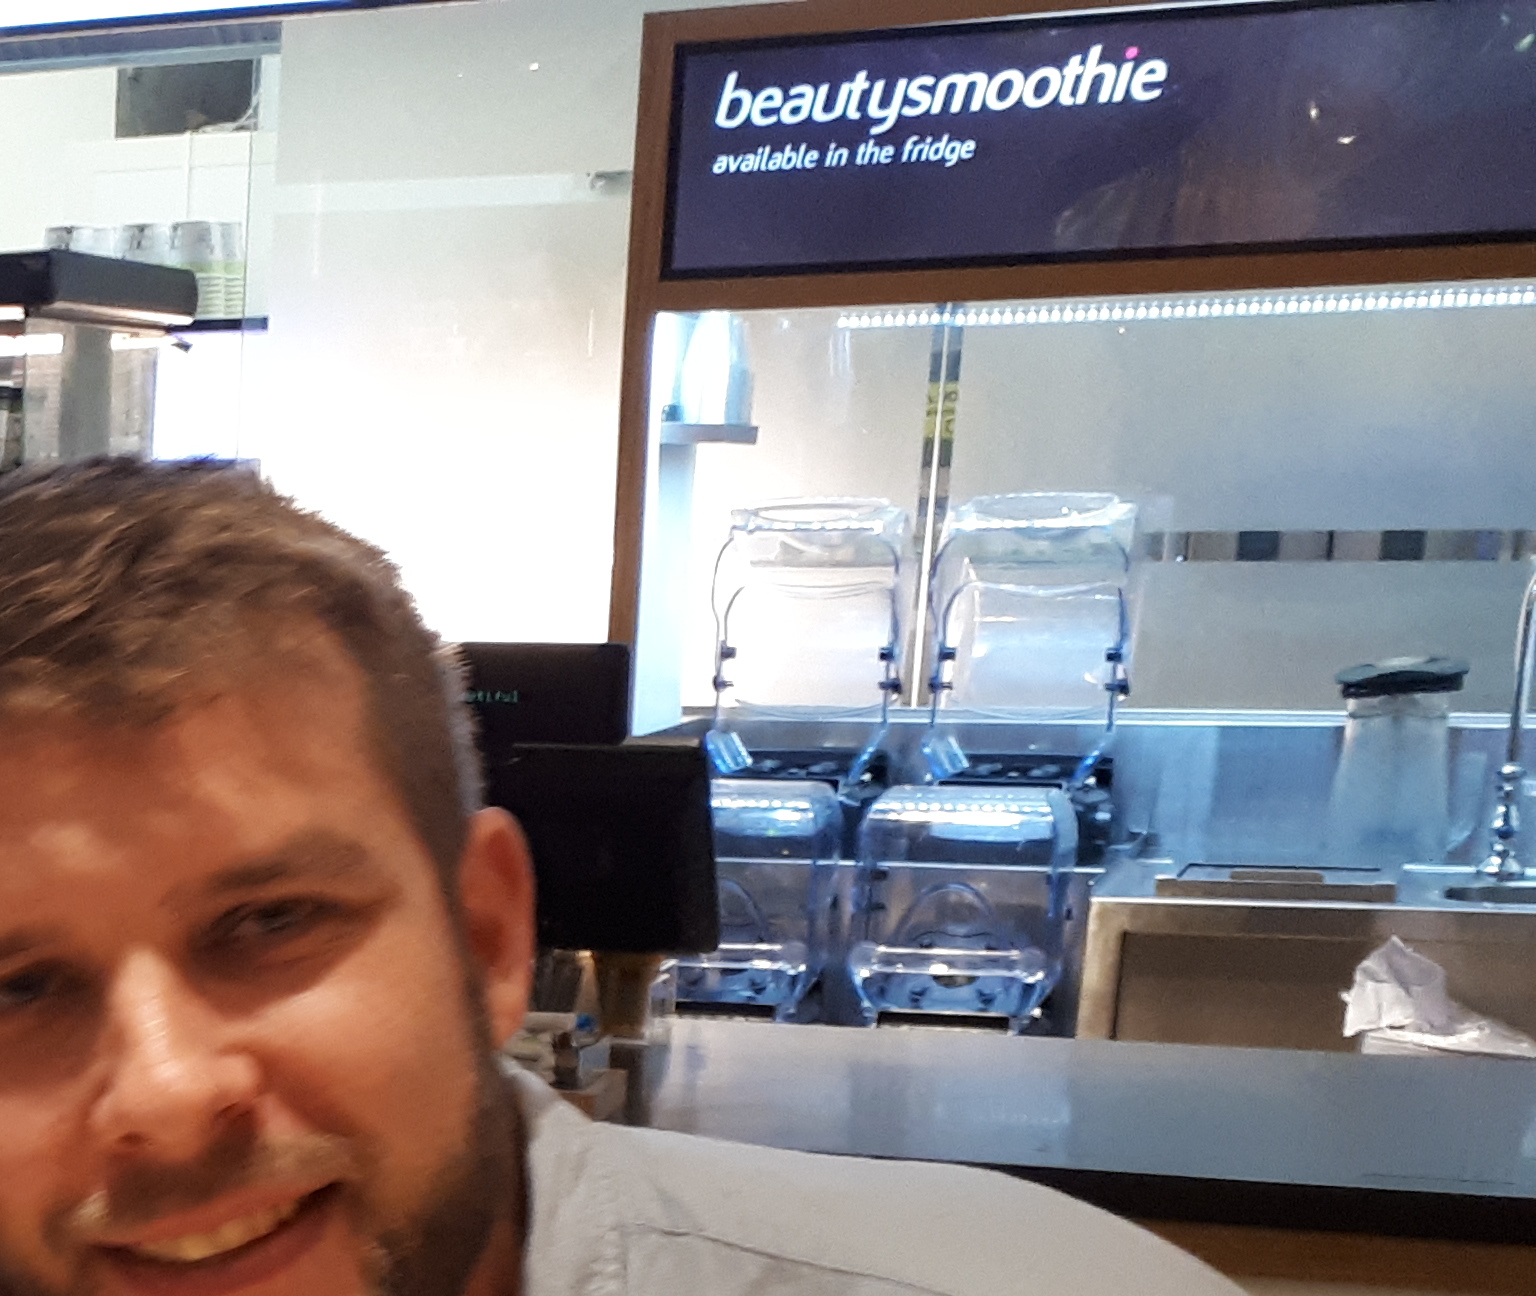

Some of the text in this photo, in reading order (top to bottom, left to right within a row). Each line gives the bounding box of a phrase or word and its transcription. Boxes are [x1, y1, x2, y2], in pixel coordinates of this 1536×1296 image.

[712, 44, 1168, 135] beautysmoothie
[711, 133, 976, 175] available in the fridge
